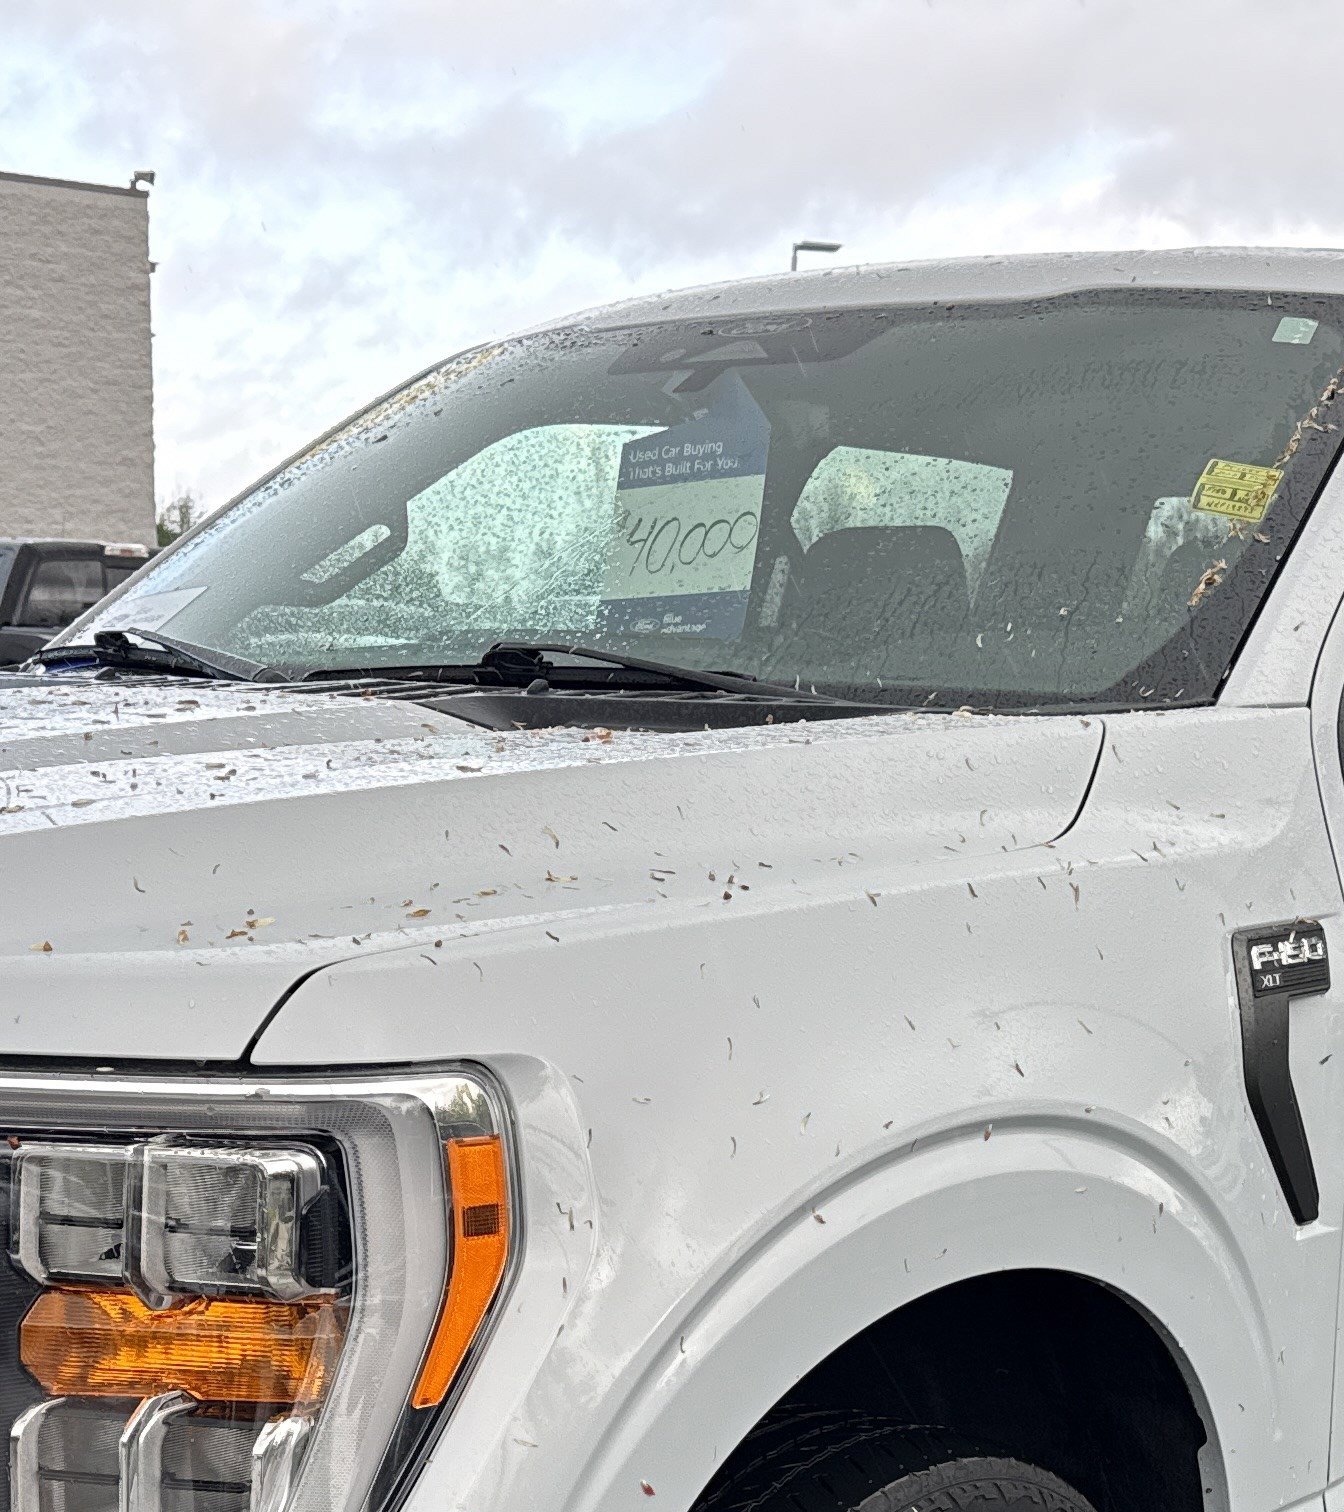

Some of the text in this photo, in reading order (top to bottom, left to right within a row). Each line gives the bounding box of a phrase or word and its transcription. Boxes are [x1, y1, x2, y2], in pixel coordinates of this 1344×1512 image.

[629, 441, 724, 463] Used Car Buying
[665, 461, 691, 476] Built
[694, 459, 712, 473] For
[1260, 973, 1282, 989] XLT
